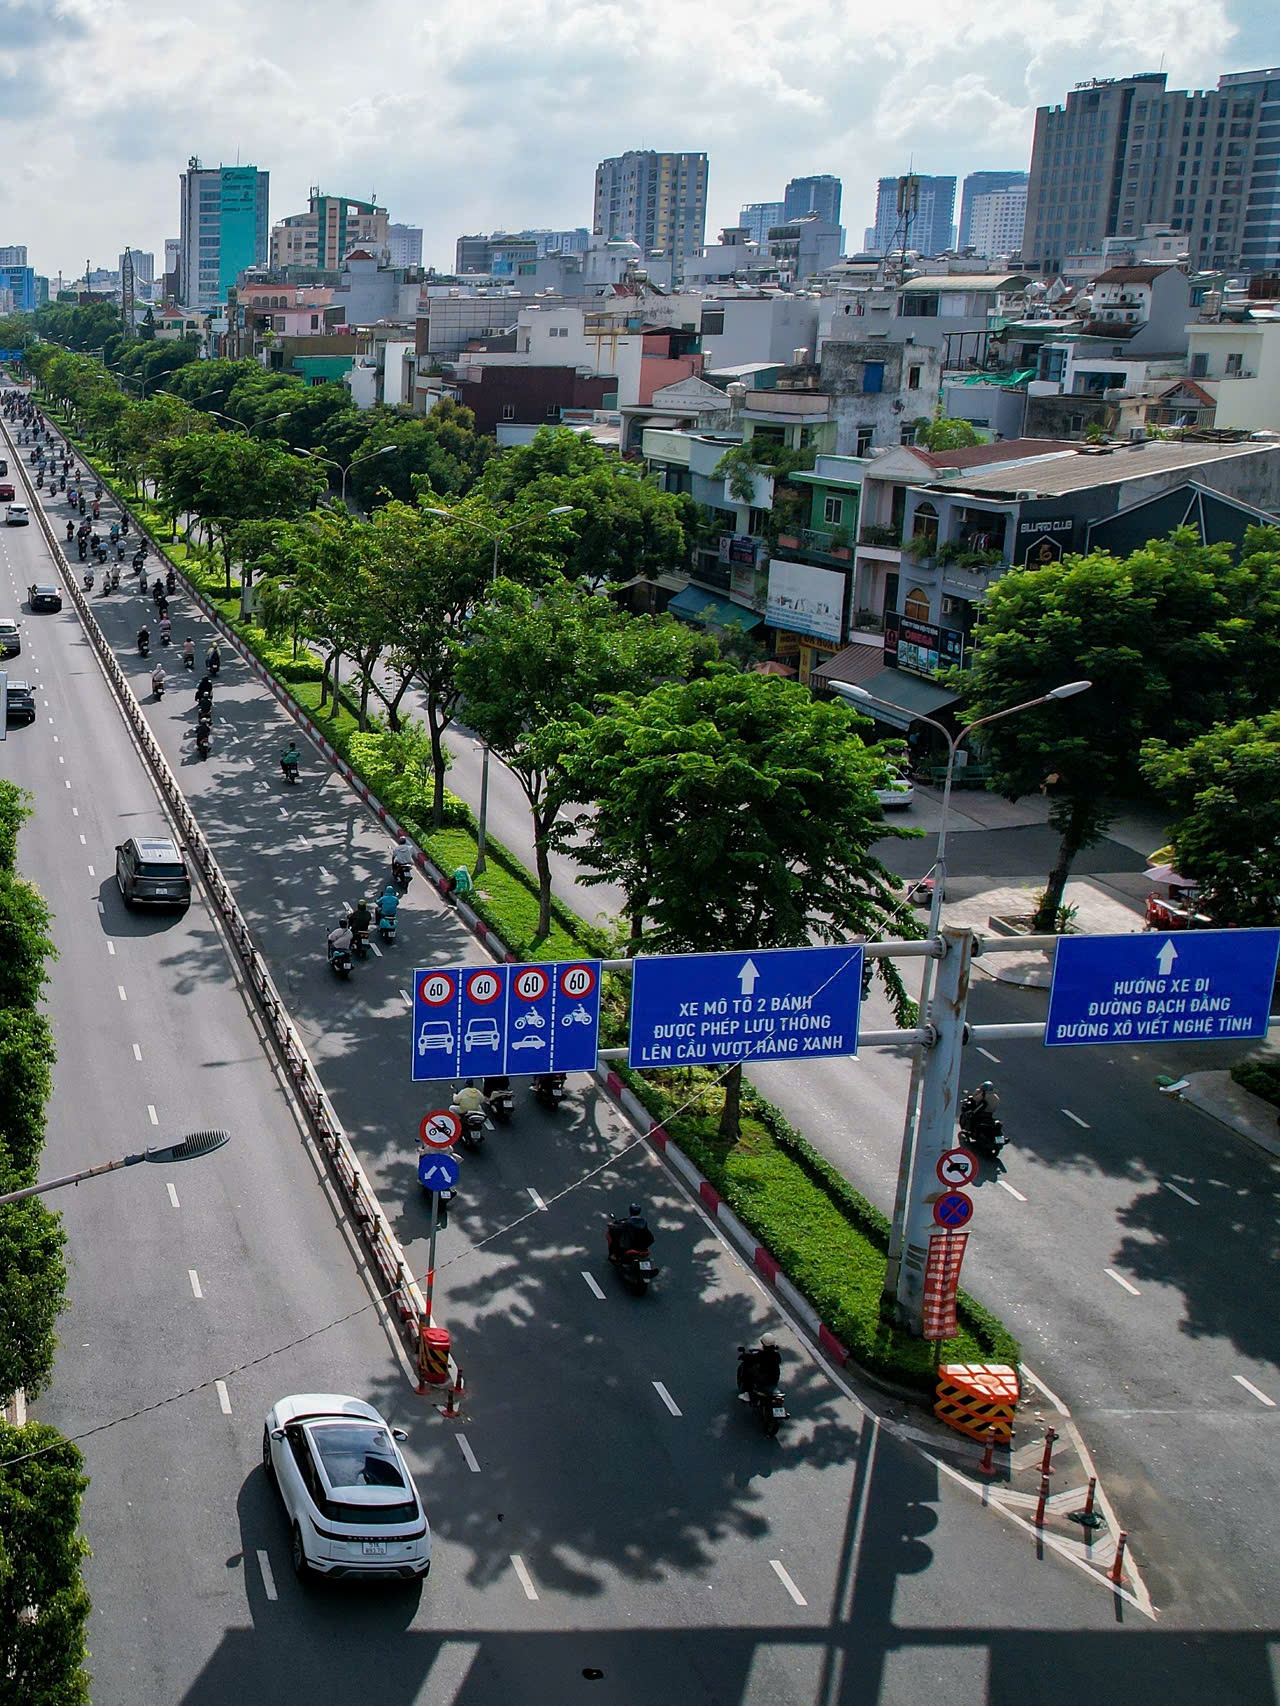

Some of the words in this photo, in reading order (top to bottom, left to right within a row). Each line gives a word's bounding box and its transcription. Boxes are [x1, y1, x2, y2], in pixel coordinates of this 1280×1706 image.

[1053, 520, 1072, 531] CLUB
[429, 983, 443, 996] 60
[476, 981, 490, 994] 60
[523, 976, 539, 993] 60
[570, 973, 585, 990] 60
[1114, 976, 1167, 995] HƯỚNG
[1170, 979, 1191, 993] XE
[1194, 977, 1210, 992] ĐI
[679, 1002, 699, 1017] XE
[703, 997, 727, 1016] MÔ
[733, 996, 752, 1013] TÔ
[757, 999, 766, 1012] 2
[771, 993, 813, 1011] BÁNH
[1088, 997, 1142, 1016] ĐƯỜNG
[1146, 998, 1186, 1017] BẠCH
[1190, 992, 1231, 1012] ĐẰNG
[653, 1021, 696, 1039] ĐƯỢC
[701, 1017, 740, 1036] PHÉP
[744, 1017, 776, 1034] LƯU
[779, 1014, 831, 1031] THÔNG
[1056, 1019, 1109, 1039] ĐƯỜNG
[1112, 1018, 1133, 1036] XÔ
[1137, 1015, 1169, 1035] VIẾT
[1172, 1016, 1214, 1035] NGHỆ
[1219, 1014, 1253, 1031] TĨNH
[641, 1043, 671, 1061] LÊN
[676, 1038, 706, 1058] CẦU
[711, 1040, 752, 1058] VƯỢT
[756, 1036, 799, 1054] HÀNG
[803, 1034, 844, 1051] XANH
